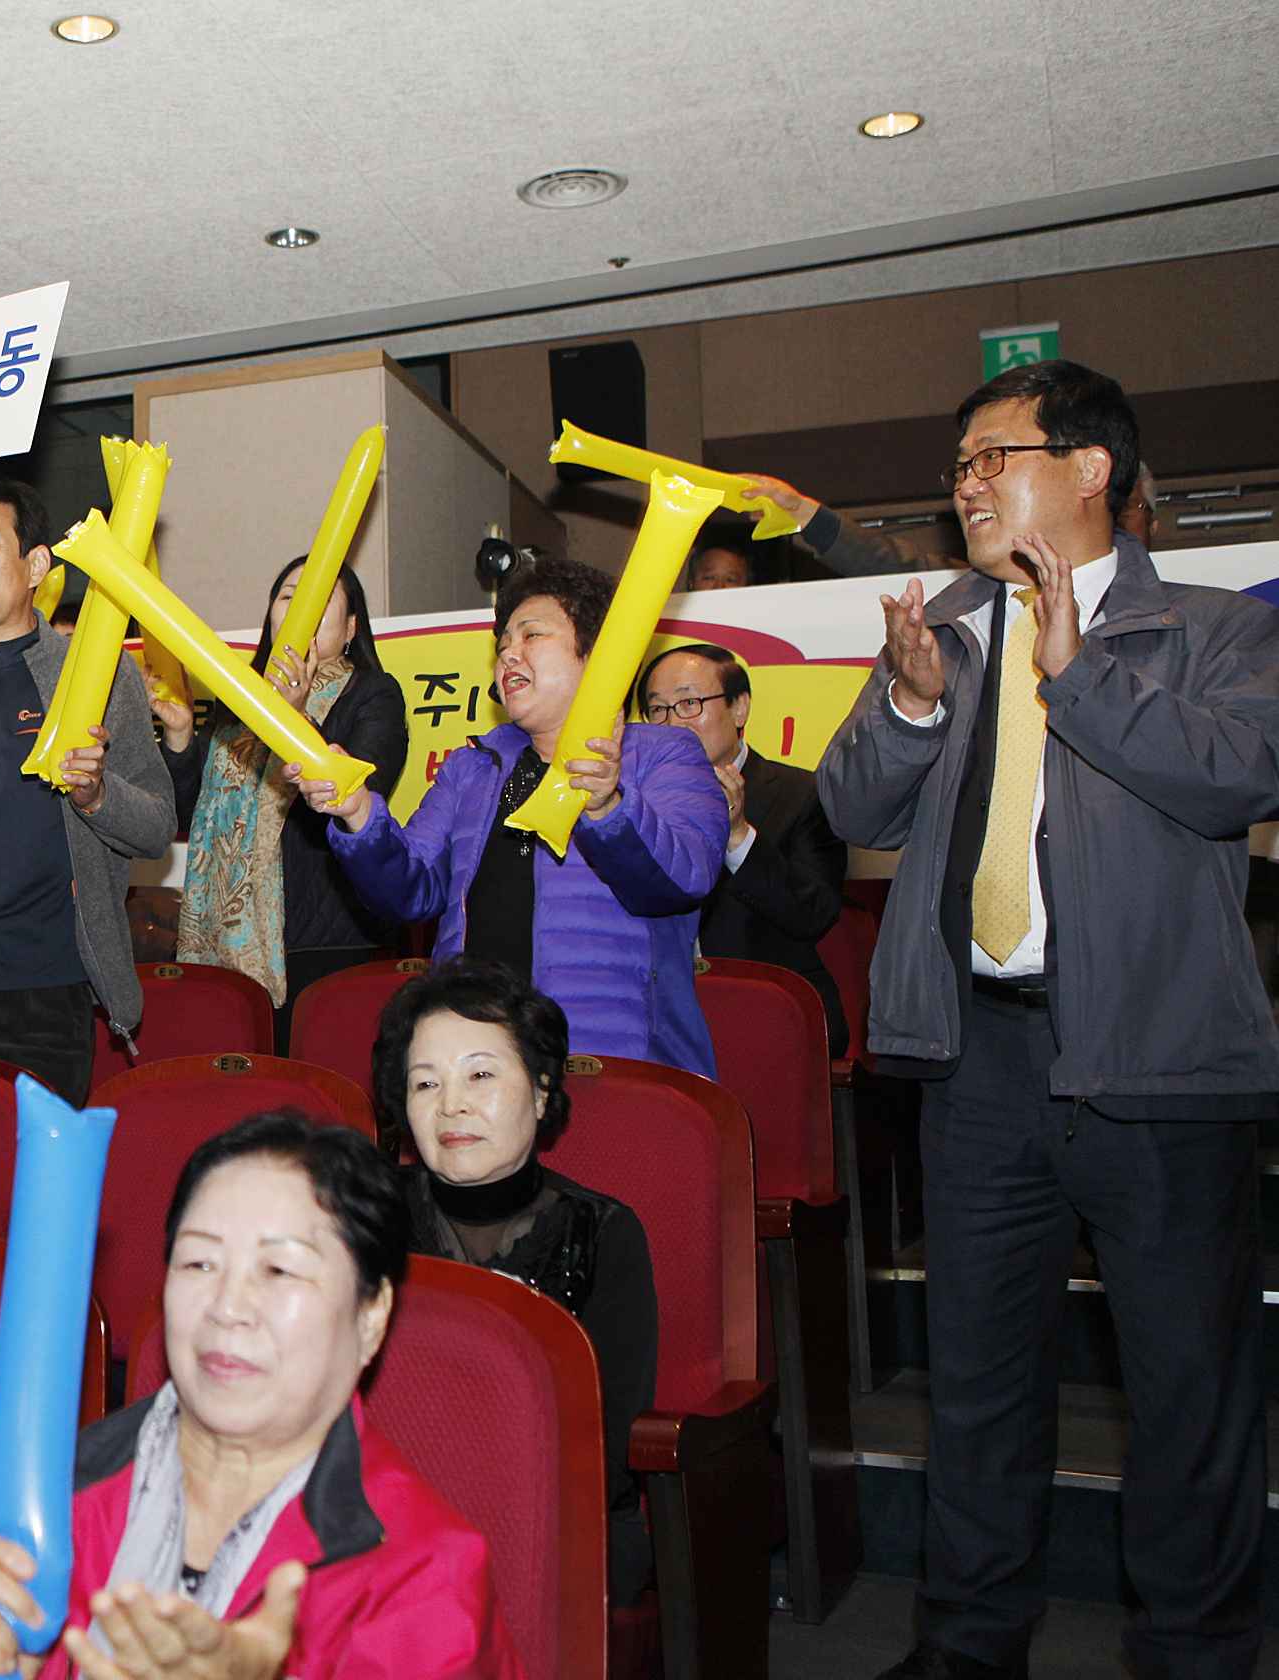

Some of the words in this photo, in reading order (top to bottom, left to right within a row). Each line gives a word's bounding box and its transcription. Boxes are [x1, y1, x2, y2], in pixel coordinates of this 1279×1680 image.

[159, 967, 166, 977] E
[403, 962, 410, 972] E
[221, 1058, 228, 1070] E
[233, 1060, 245, 1070] 72
[566, 1060, 575, 1073] E
[581, 1061, 593, 1072] 71
